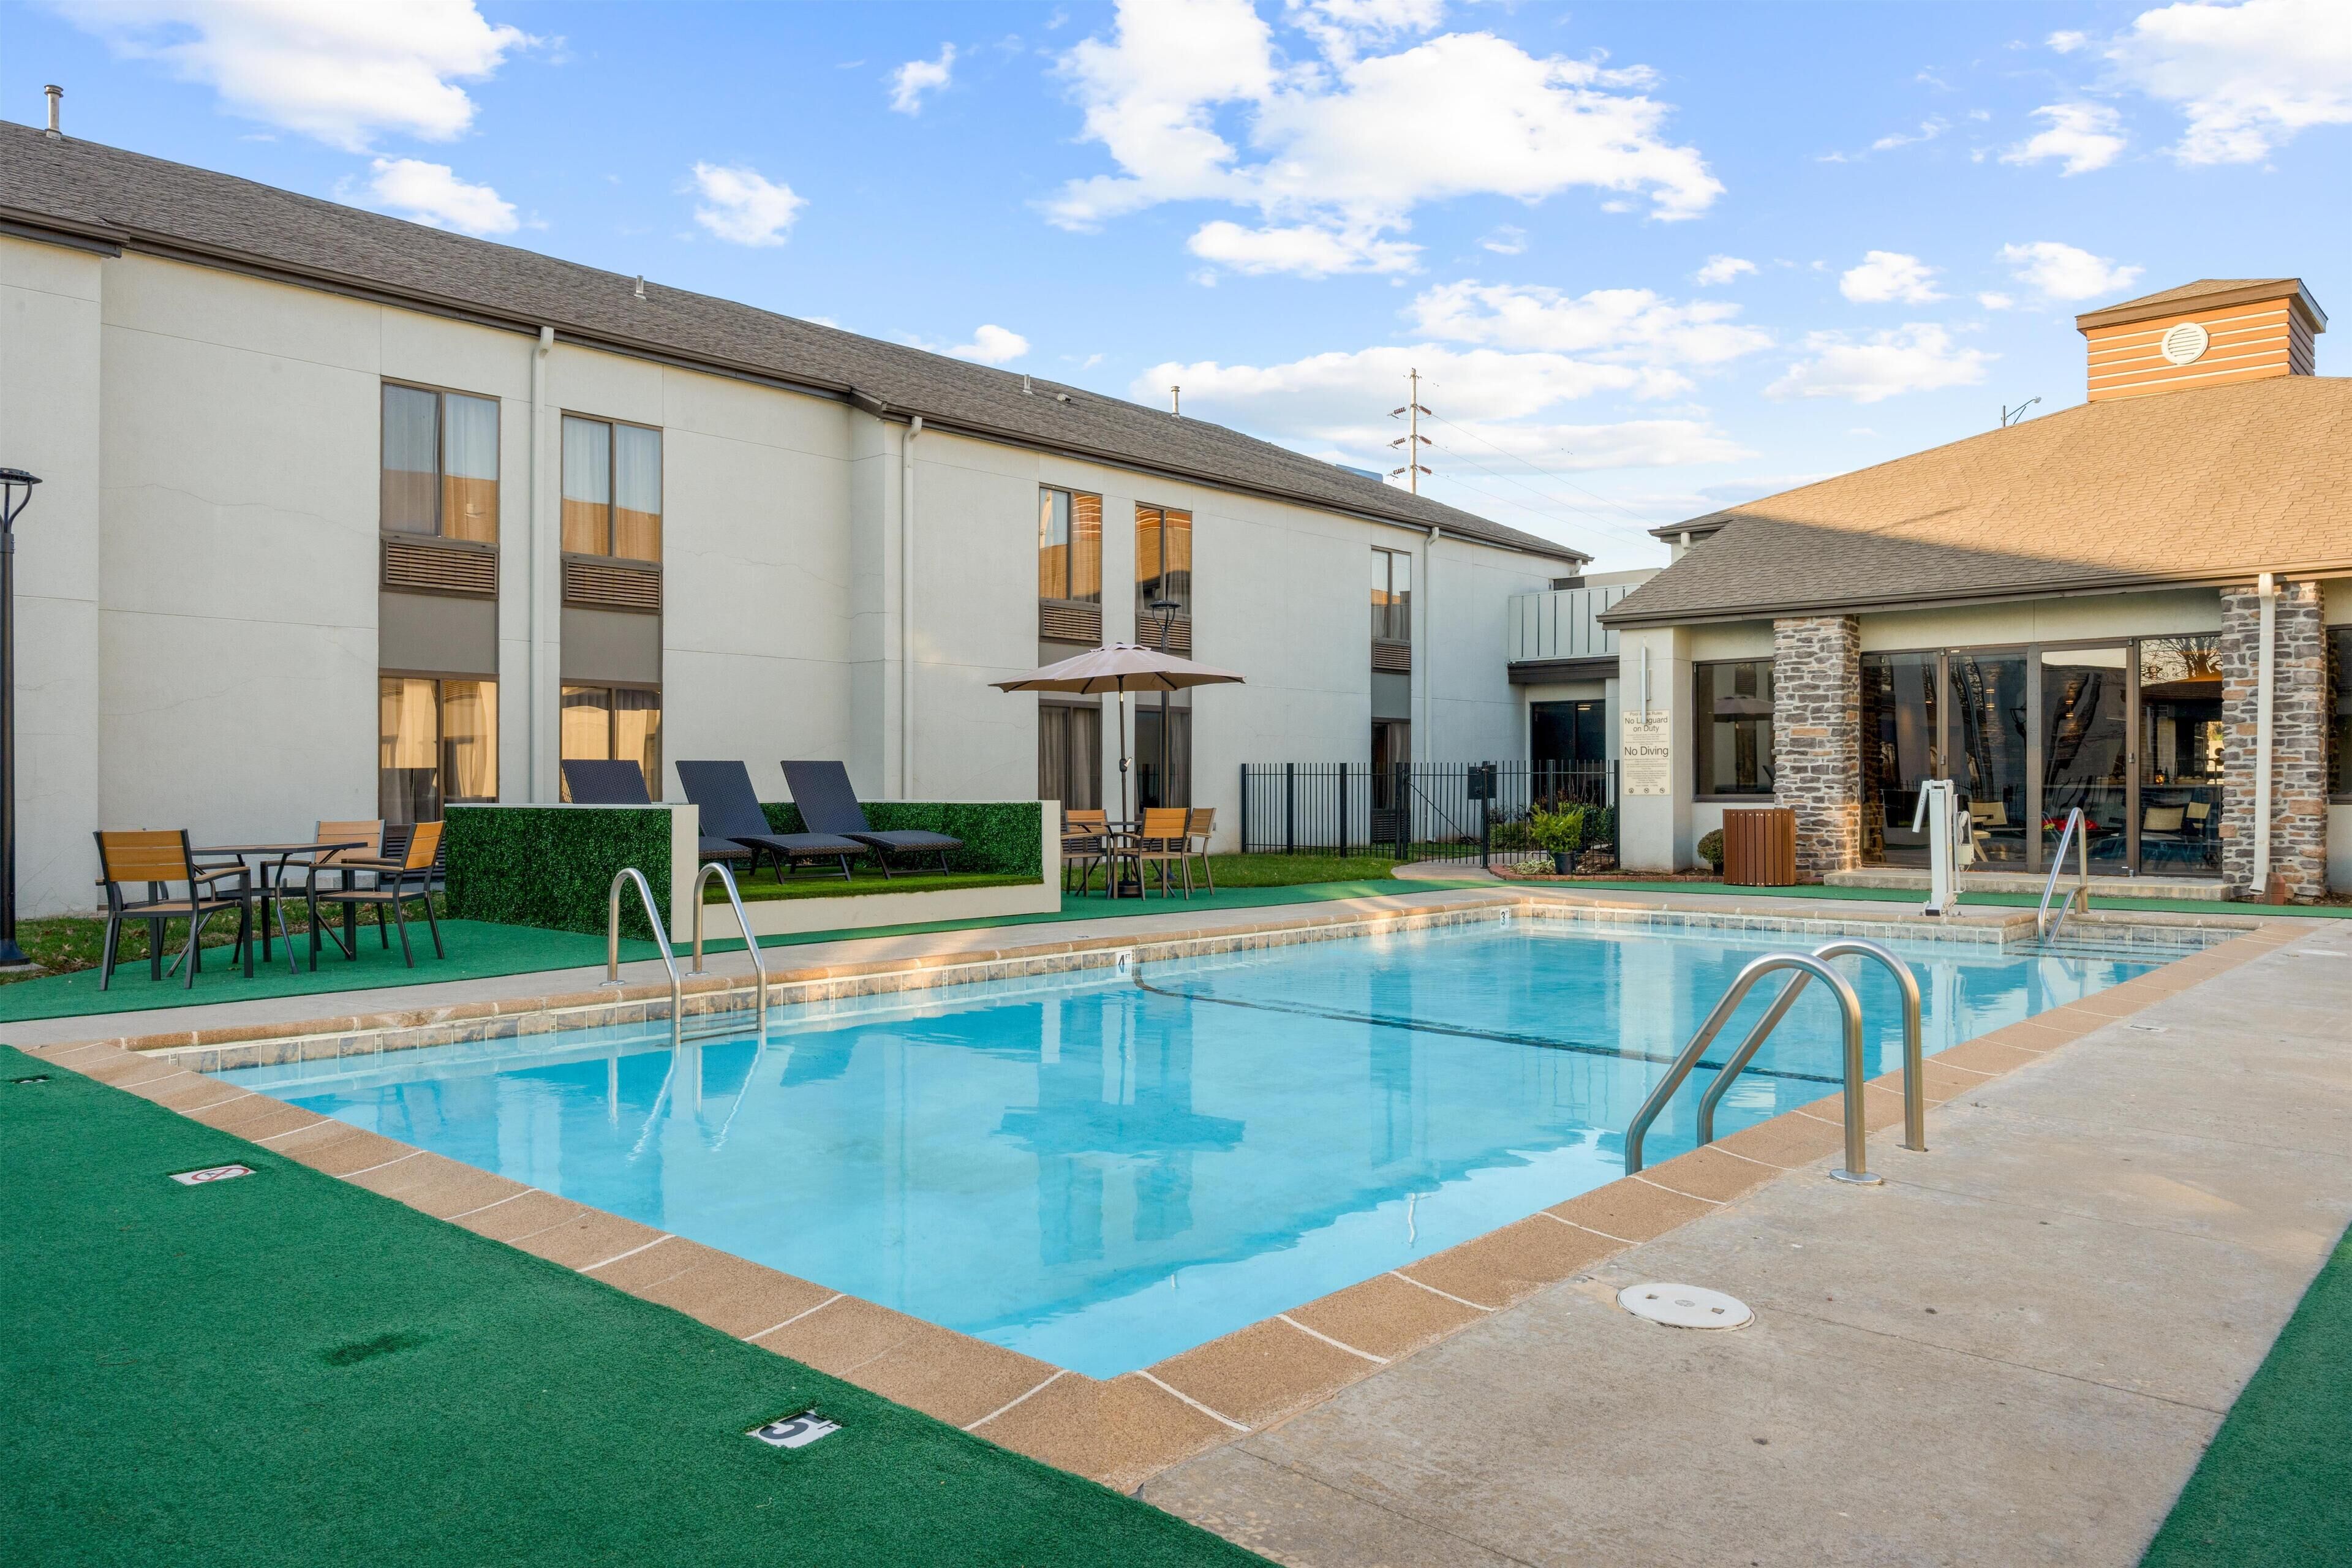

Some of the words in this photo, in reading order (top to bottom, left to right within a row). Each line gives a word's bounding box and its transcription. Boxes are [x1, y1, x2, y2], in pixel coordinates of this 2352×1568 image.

[1624, 747, 1637, 755] No
[1640, 746, 1668, 757] Diving
[759, 1411, 829, 1440] 5
